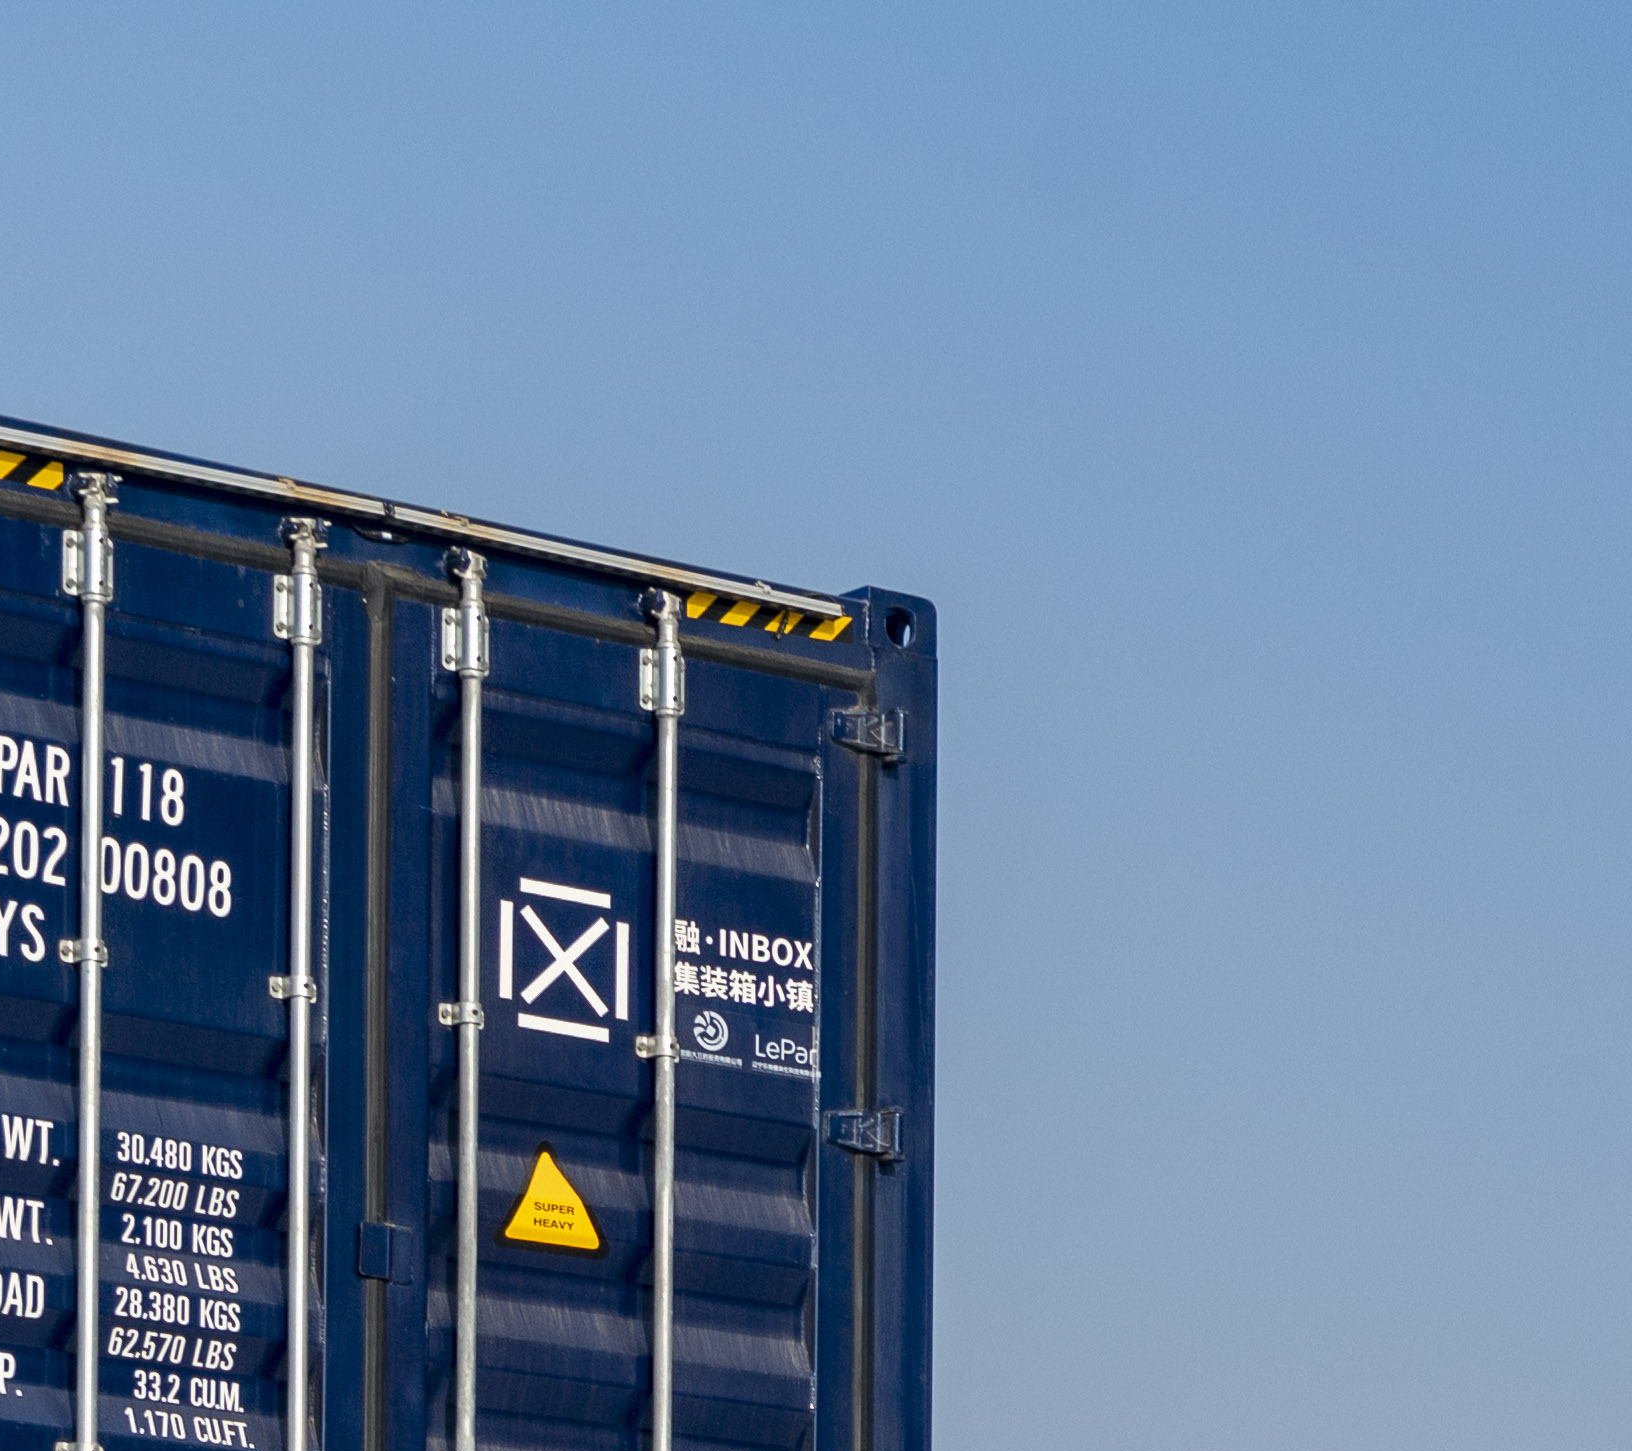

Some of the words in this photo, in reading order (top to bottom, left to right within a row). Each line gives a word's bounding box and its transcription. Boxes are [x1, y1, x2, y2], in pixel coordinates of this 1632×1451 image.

[673, 961, 814, 1013] 集装箱小镇
[2, 1114, 59, 1166] WT.
[118, 1132, 191, 1171] 30.480
[202, 1145, 242, 1179] KGS
[111, 1173, 188, 1210] 67.200
[195, 1185, 239, 1218] LBS
[533, 1201, 576, 1216] SUPER
[122, 1214, 182, 1250] 2.100
[193, 1224, 233, 1257] KGS
[533, 1217, 576, 1232] HEAVY
[126, 1253, 187, 1286] 4.630
[194, 1263, 238, 1293] LBS
[115, 1287, 189, 1325] 28.380
[200, 1299, 240, 1332] KGS
[108, 1327, 186, 1363] 62.570
[192, 1339, 236, 1370] LBS
[134, 1370, 180, 1404] 33.2
[191, 1378, 244, 1412] CU.M.
[125, 1407, 186, 1439] 1.170
